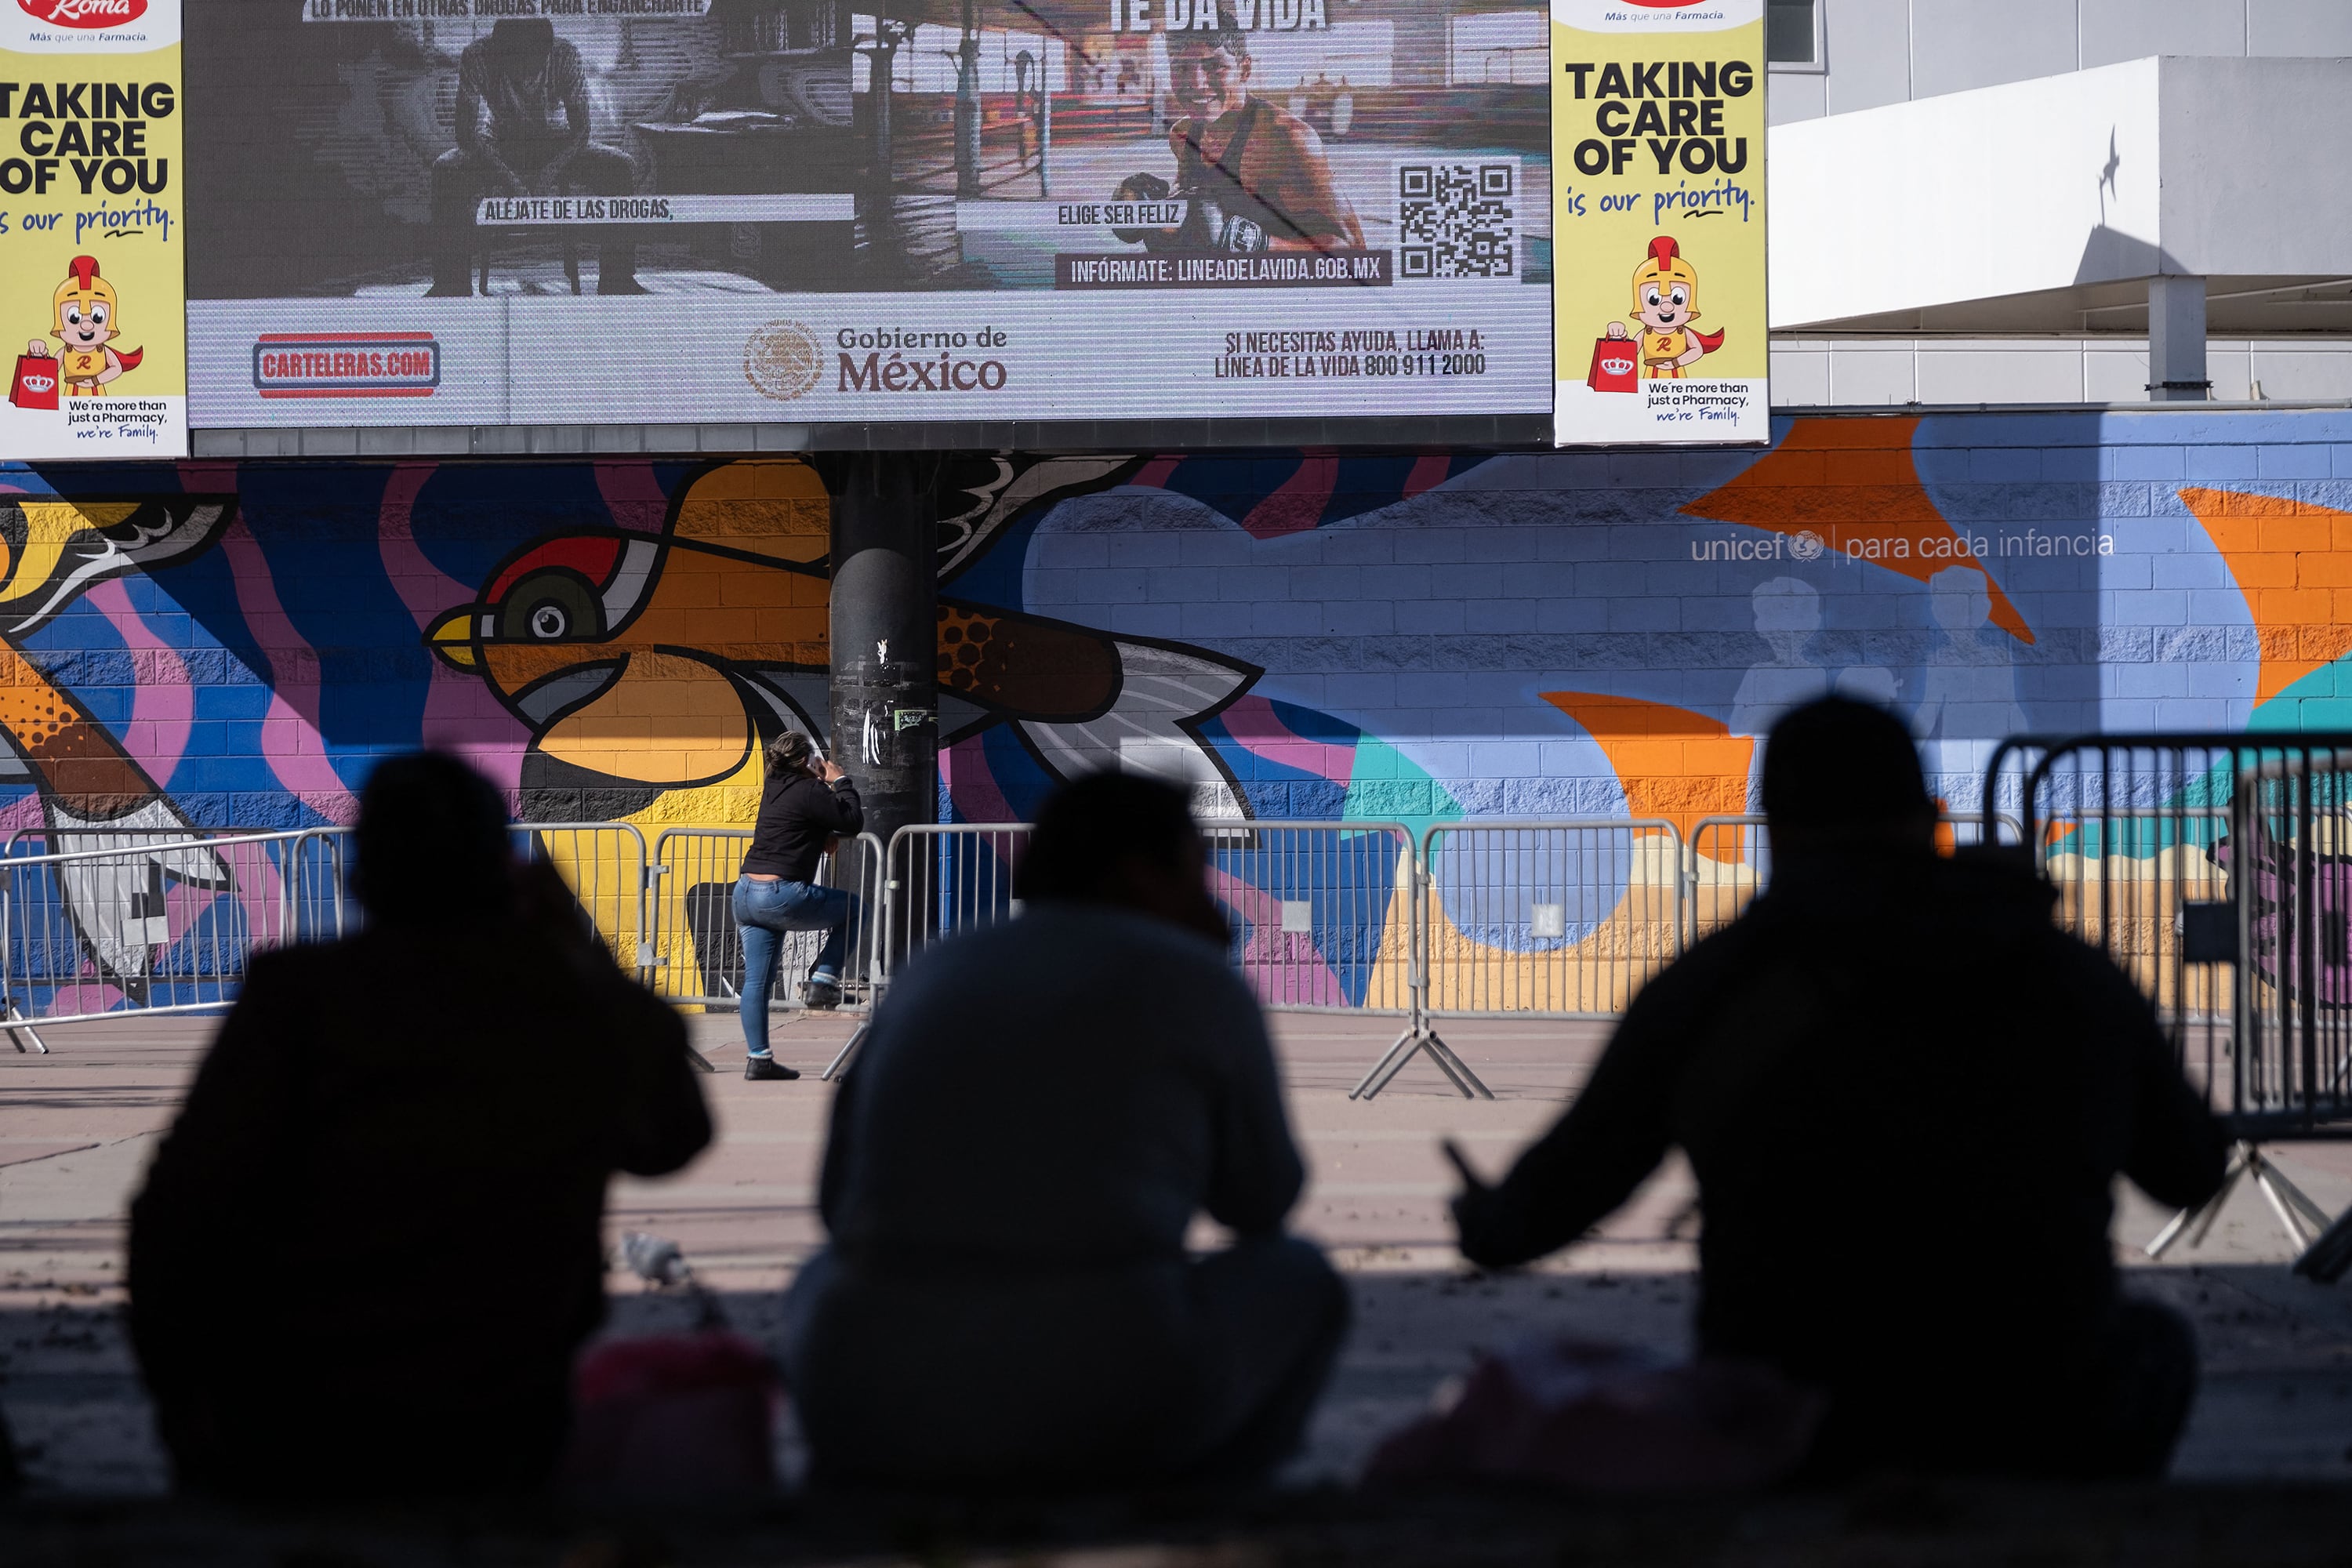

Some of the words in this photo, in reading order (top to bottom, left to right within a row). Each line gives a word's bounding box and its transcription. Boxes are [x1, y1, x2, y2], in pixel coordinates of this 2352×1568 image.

[336, 0, 389, 16] PONEN
[393, 0, 413, 16] EN
[1165, 0, 1218, 30] DA
[1236, 0, 1327, 29] VIDA
[1605, 11, 1627, 21] Más
[1631, 13, 1650, 23] que
[30, 32, 52, 42] Más
[55, 34, 74, 43] que
[1566, 60, 1753, 100] TAKING
[0, 82, 175, 118] TAKING
[1596, 100, 1725, 137] CARE
[20, 121, 147, 157] CARE
[1573, 138, 1636, 176] OF
[1646, 137, 1748, 175] YOU
[0, 158, 60, 194] OF
[70, 158, 168, 194] YOU
[553, 200, 572, 220] DE
[577, 199, 604, 219] LAS
[609, 198, 673, 220] DROGAS,
[1567, 186, 1587, 216] is
[1600, 193, 1641, 212] our
[1654, 178, 1755, 226] priority.
[23, 212, 63, 230] our
[76, 198, 175, 245] priority.
[1058, 205, 1102, 226] ELIGE
[1104, 205, 1134, 225] SER
[1138, 204, 1180, 224] FELIZ
[1072, 256, 1173, 283] INFÓRMATE:
[1178, 257, 1381, 281] LINEADELAVIDA.GOB.MX
[837, 326, 967, 349] Gobierno
[975, 325, 1007, 348] de
[1226, 332, 1241, 353] SI
[1247, 331, 1336, 353] NECESITAS
[1341, 330, 1402, 353] AYUDA,
[1407, 329, 1461, 352] LLAMA
[1469, 328, 1485, 350] A:
[1656, 336, 1671, 352] R
[76, 354, 92, 369] R
[263, 351, 430, 378] CARTELERAS.COM
[837, 351, 1007, 392] México
[1269, 356, 1290, 378] DE
[1295, 355, 1316, 377] LA
[1321, 354, 1360, 377] VIDA
[1365, 354, 1398, 376] 800
[1403, 354, 1436, 376] 911
[1442, 354, 1486, 375] 2000
[1686, 384, 1718, 394] more
[1719, 383, 1748, 393] than
[105, 402, 136, 411] more
[139, 401, 167, 410] than
[1647, 395, 1670, 408] just
[1682, 395, 1749, 408] Pharmacy,
[68, 412, 90, 426] just
[103, 412, 167, 424] Pharmacy,
[1699, 407, 1740, 427] Family.
[118, 424, 158, 444] Family.
[1692, 532, 1784, 561] unicef
[1847, 535, 1910, 564] para
[1919, 529, 1989, 558] cada
[1999, 528, 2117, 557] infancia
